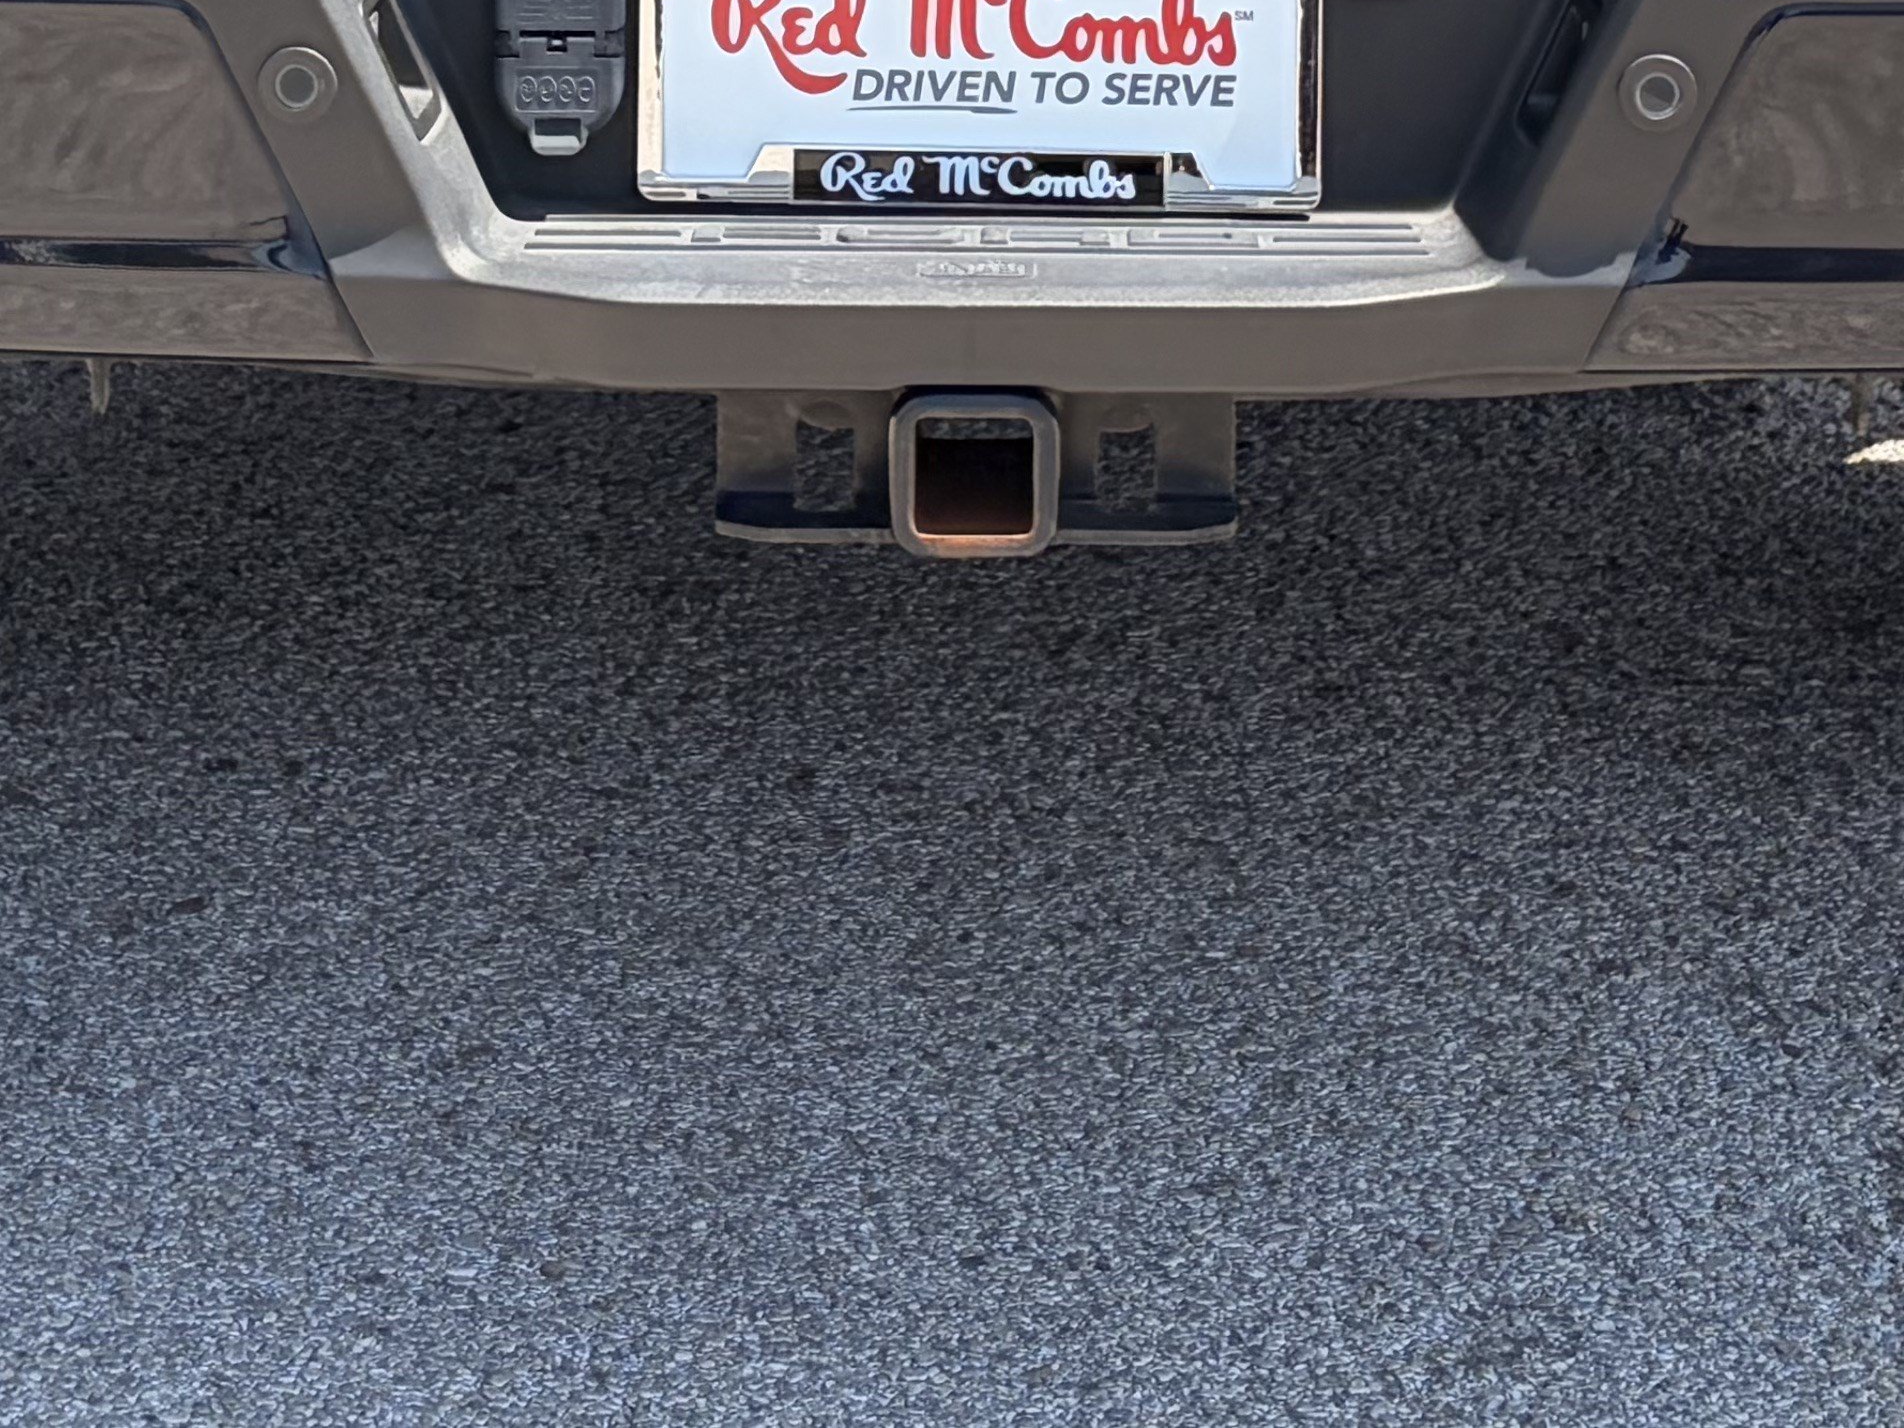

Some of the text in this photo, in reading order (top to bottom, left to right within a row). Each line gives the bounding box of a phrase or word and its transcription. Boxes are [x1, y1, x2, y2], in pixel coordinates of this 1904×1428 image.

[851, 68, 1238, 108] DRIVEN TO SERVE
[818, 151, 1137, 201] Red McCombs
